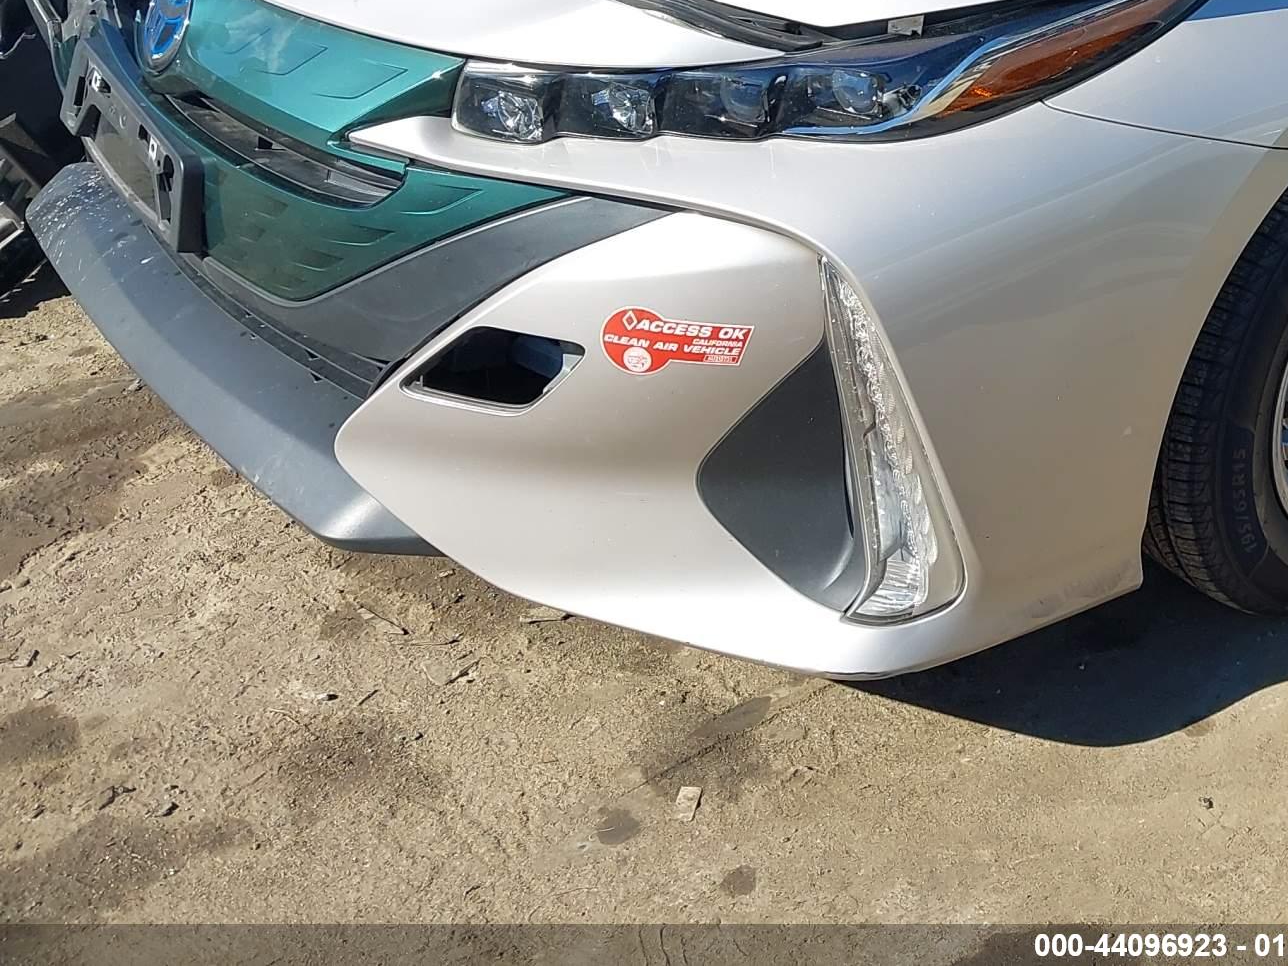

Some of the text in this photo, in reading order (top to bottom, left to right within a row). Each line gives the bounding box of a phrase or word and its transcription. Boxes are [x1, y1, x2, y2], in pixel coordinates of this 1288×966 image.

[636, 318, 749, 340] ACCESS OK
[604, 333, 742, 356] CLEAN AIR VEHICLE
[692, 338, 743, 348] CALIFORNIA
